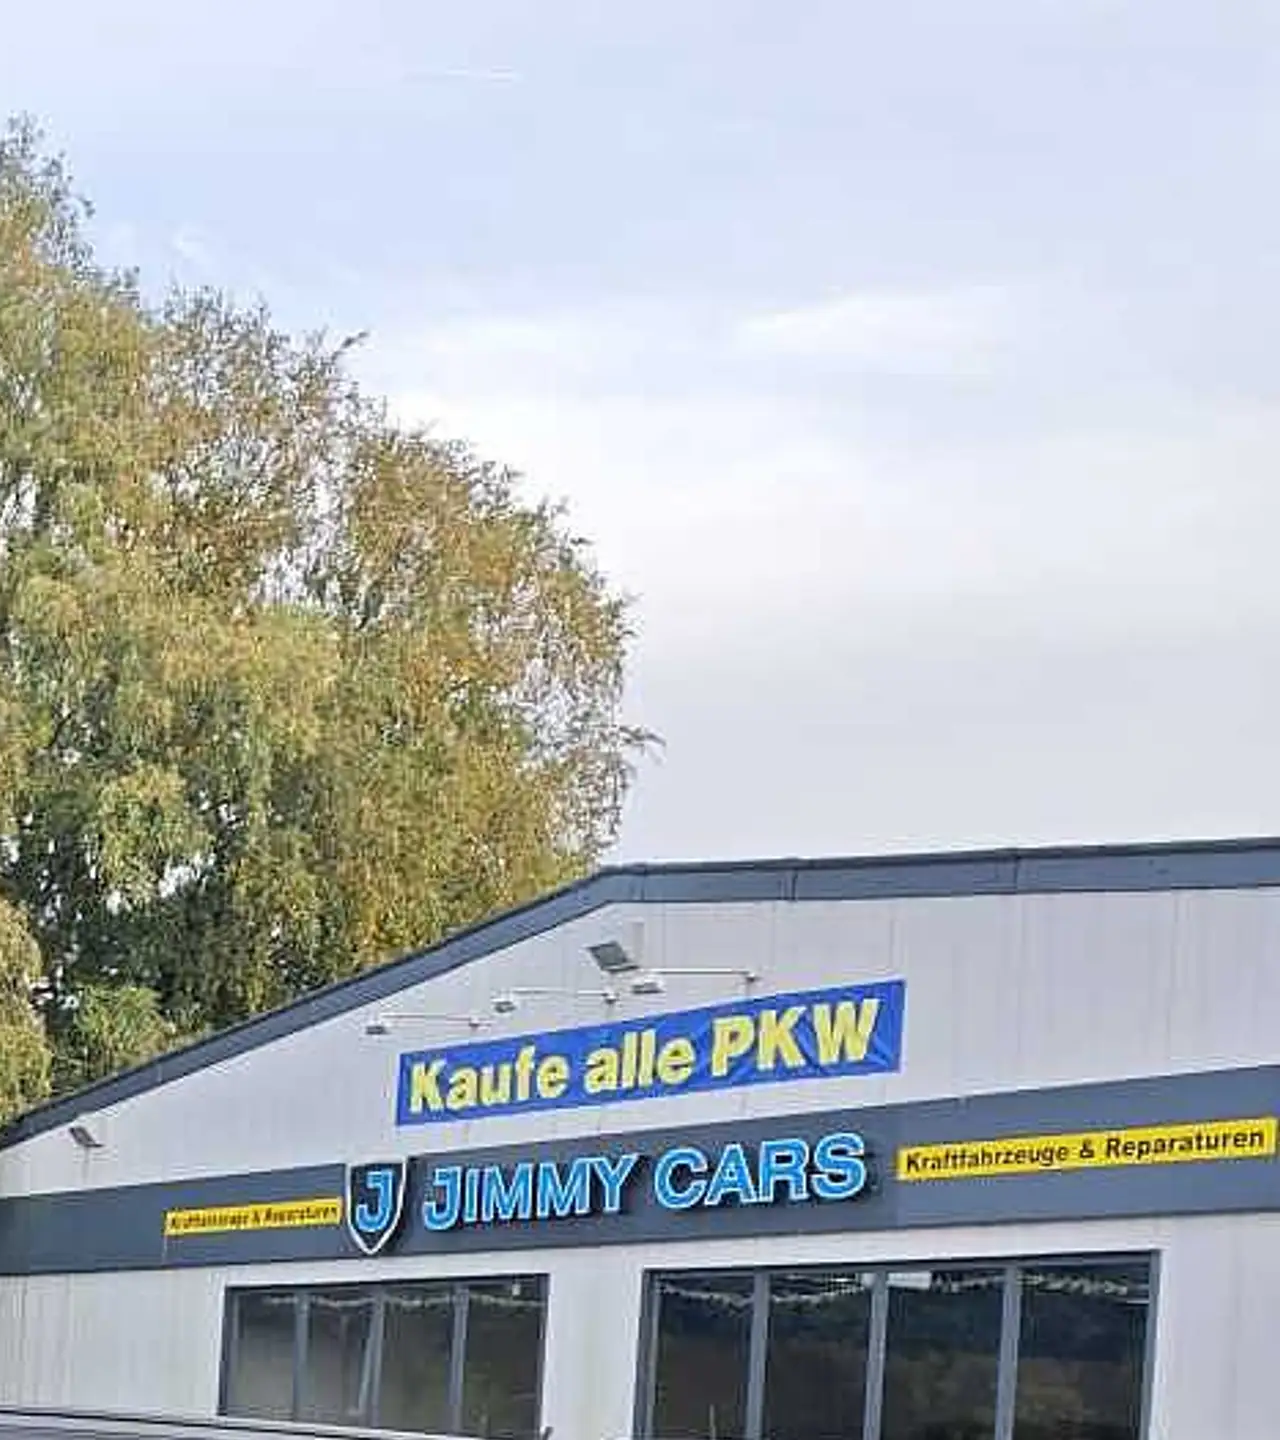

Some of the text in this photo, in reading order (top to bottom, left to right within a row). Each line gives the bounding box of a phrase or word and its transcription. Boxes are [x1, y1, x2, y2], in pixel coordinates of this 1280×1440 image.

[408, 998, 881, 1114] Kaufe alle PKW
[423, 1132, 867, 1231] JIMMY CARS
[905, 1127, 1265, 1174] Kraftfahrzeuge & Reparaturen
[355, 1171, 393, 1232] J
